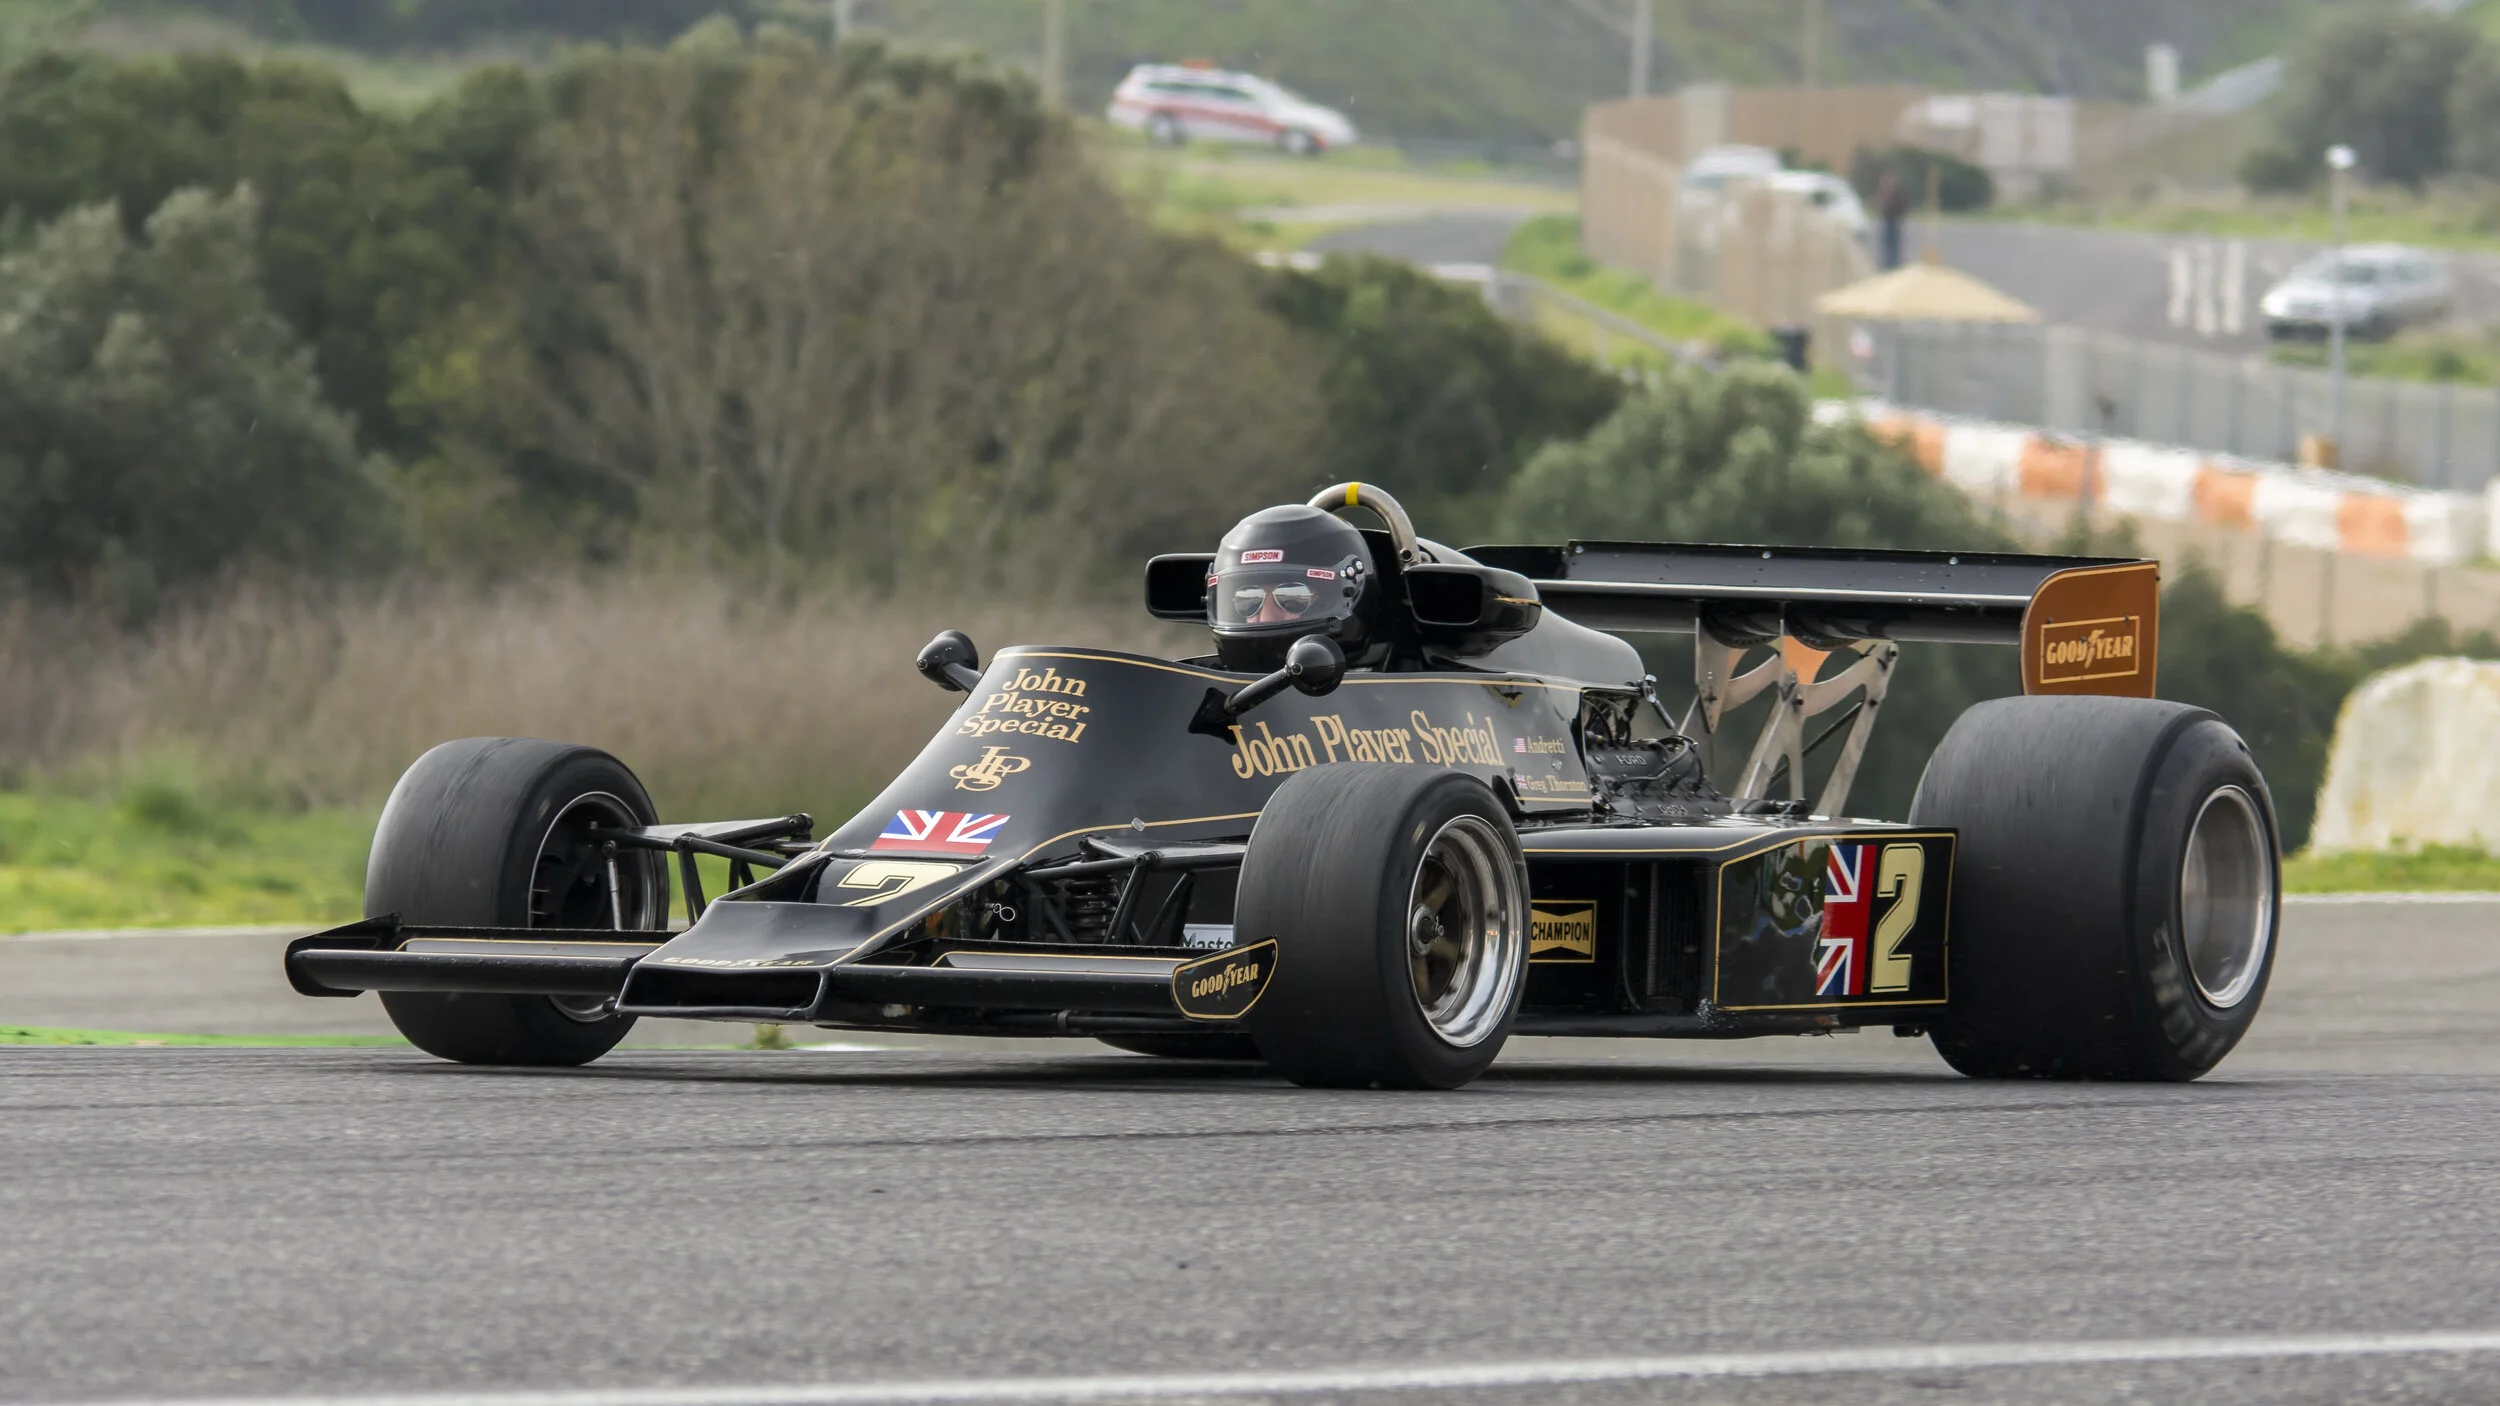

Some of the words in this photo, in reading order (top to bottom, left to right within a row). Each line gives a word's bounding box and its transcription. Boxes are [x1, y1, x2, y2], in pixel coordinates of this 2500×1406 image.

[1244, 551, 1280, 561] SIMPSON
[1308, 570, 1333, 579] SIMPSON
[2046, 629, 2133, 670] GOODYEAR
[1003, 668, 1087, 697] John
[977, 692, 1090, 720] Player
[956, 715, 1087, 744] Special
[1228, 721, 1317, 779] John
[1411, 709, 1506, 768] Special
[1527, 736, 1566, 754] Andretti
[1616, 755, 1647, 766] FORD
[1526, 775, 1548, 793] Greg
[1531, 922, 1590, 941] CHAMPION
[1870, 842, 1925, 993] 2
[1192, 963, 1259, 998] GOODYEAR
